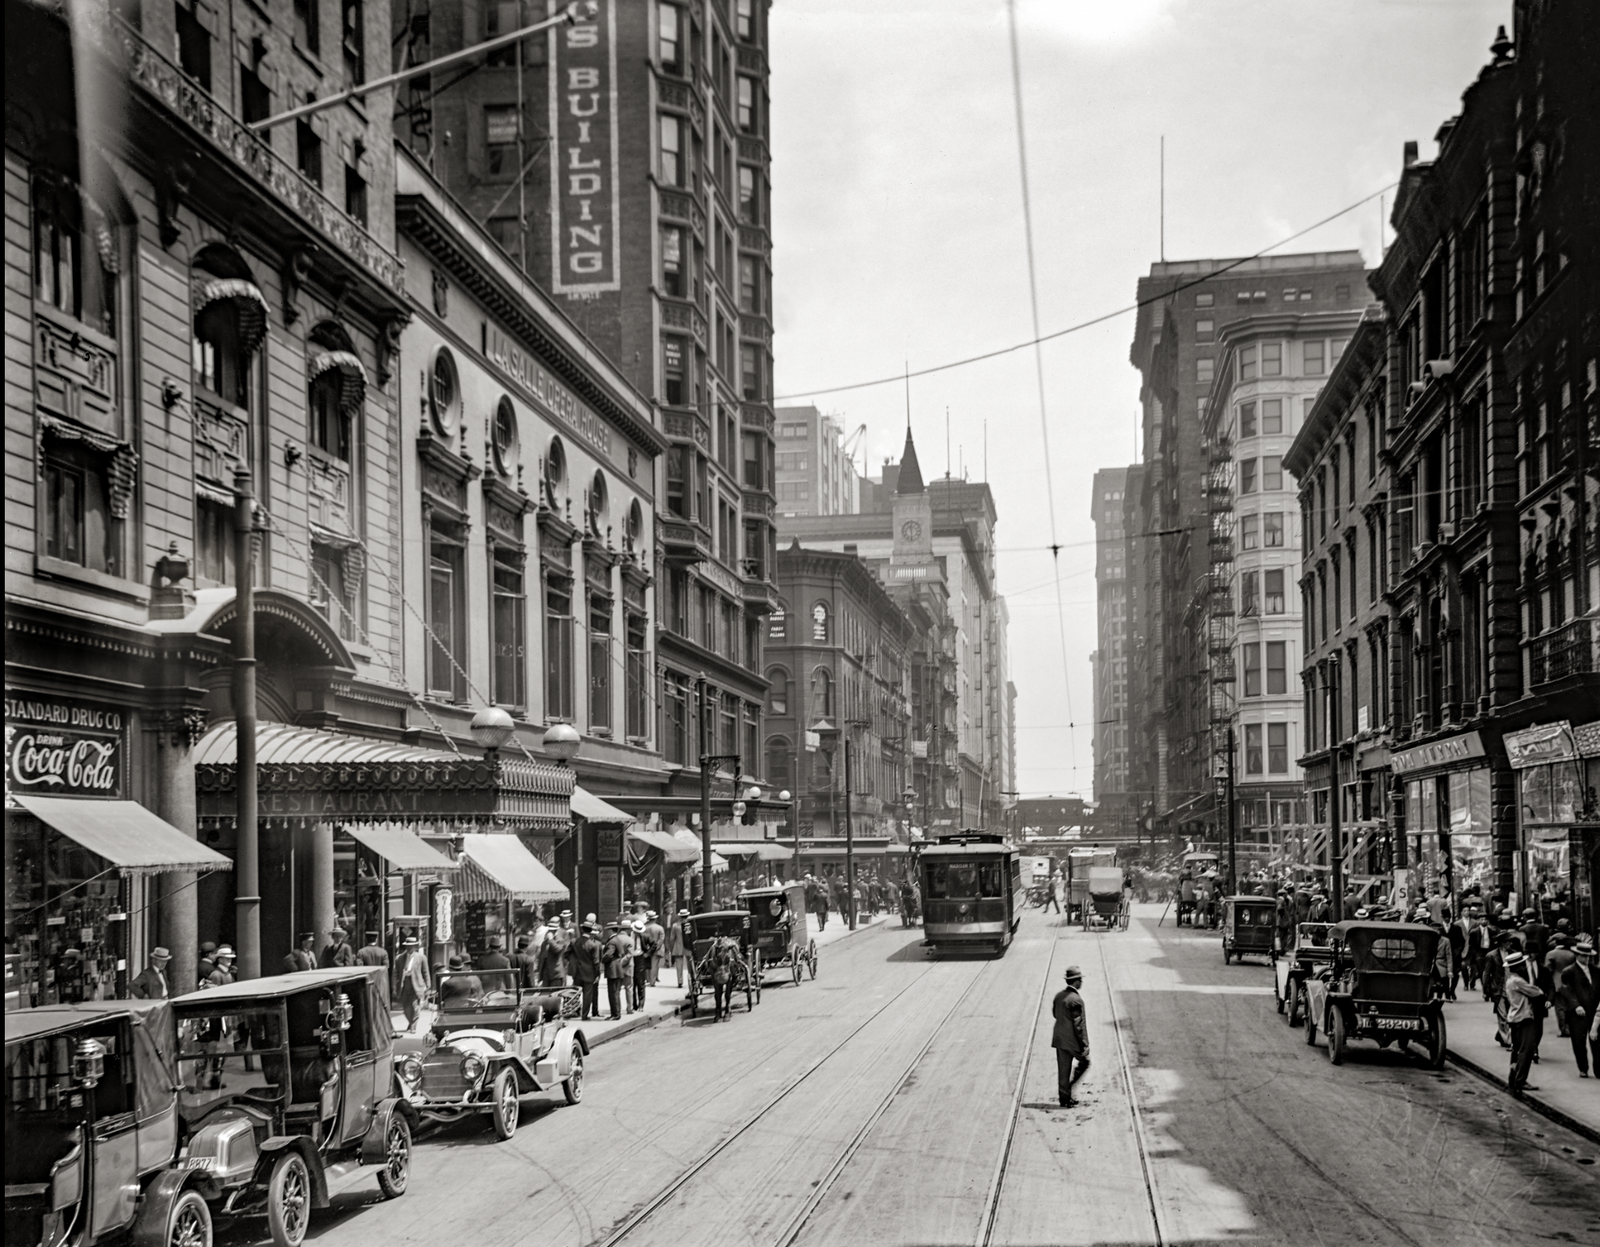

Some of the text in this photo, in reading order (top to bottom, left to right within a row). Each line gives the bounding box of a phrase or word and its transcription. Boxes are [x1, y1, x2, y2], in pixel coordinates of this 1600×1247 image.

[567, 67, 603, 273] BUILDING
[493, 329, 609, 454] LA SALLE OPERA HOUSE
[5, 698, 123, 730] STANDARD DRUG CO.
[36, 735, 64, 746] DRINK
[1391, 738, 1469, 771] TOM MURRAY
[12, 735, 115, 789] Coca-Cola
[220, 771, 298, 784] HEL
[257, 791, 421, 812] RESTAURANT
[1377, 1018, 1419, 1031] 23204
